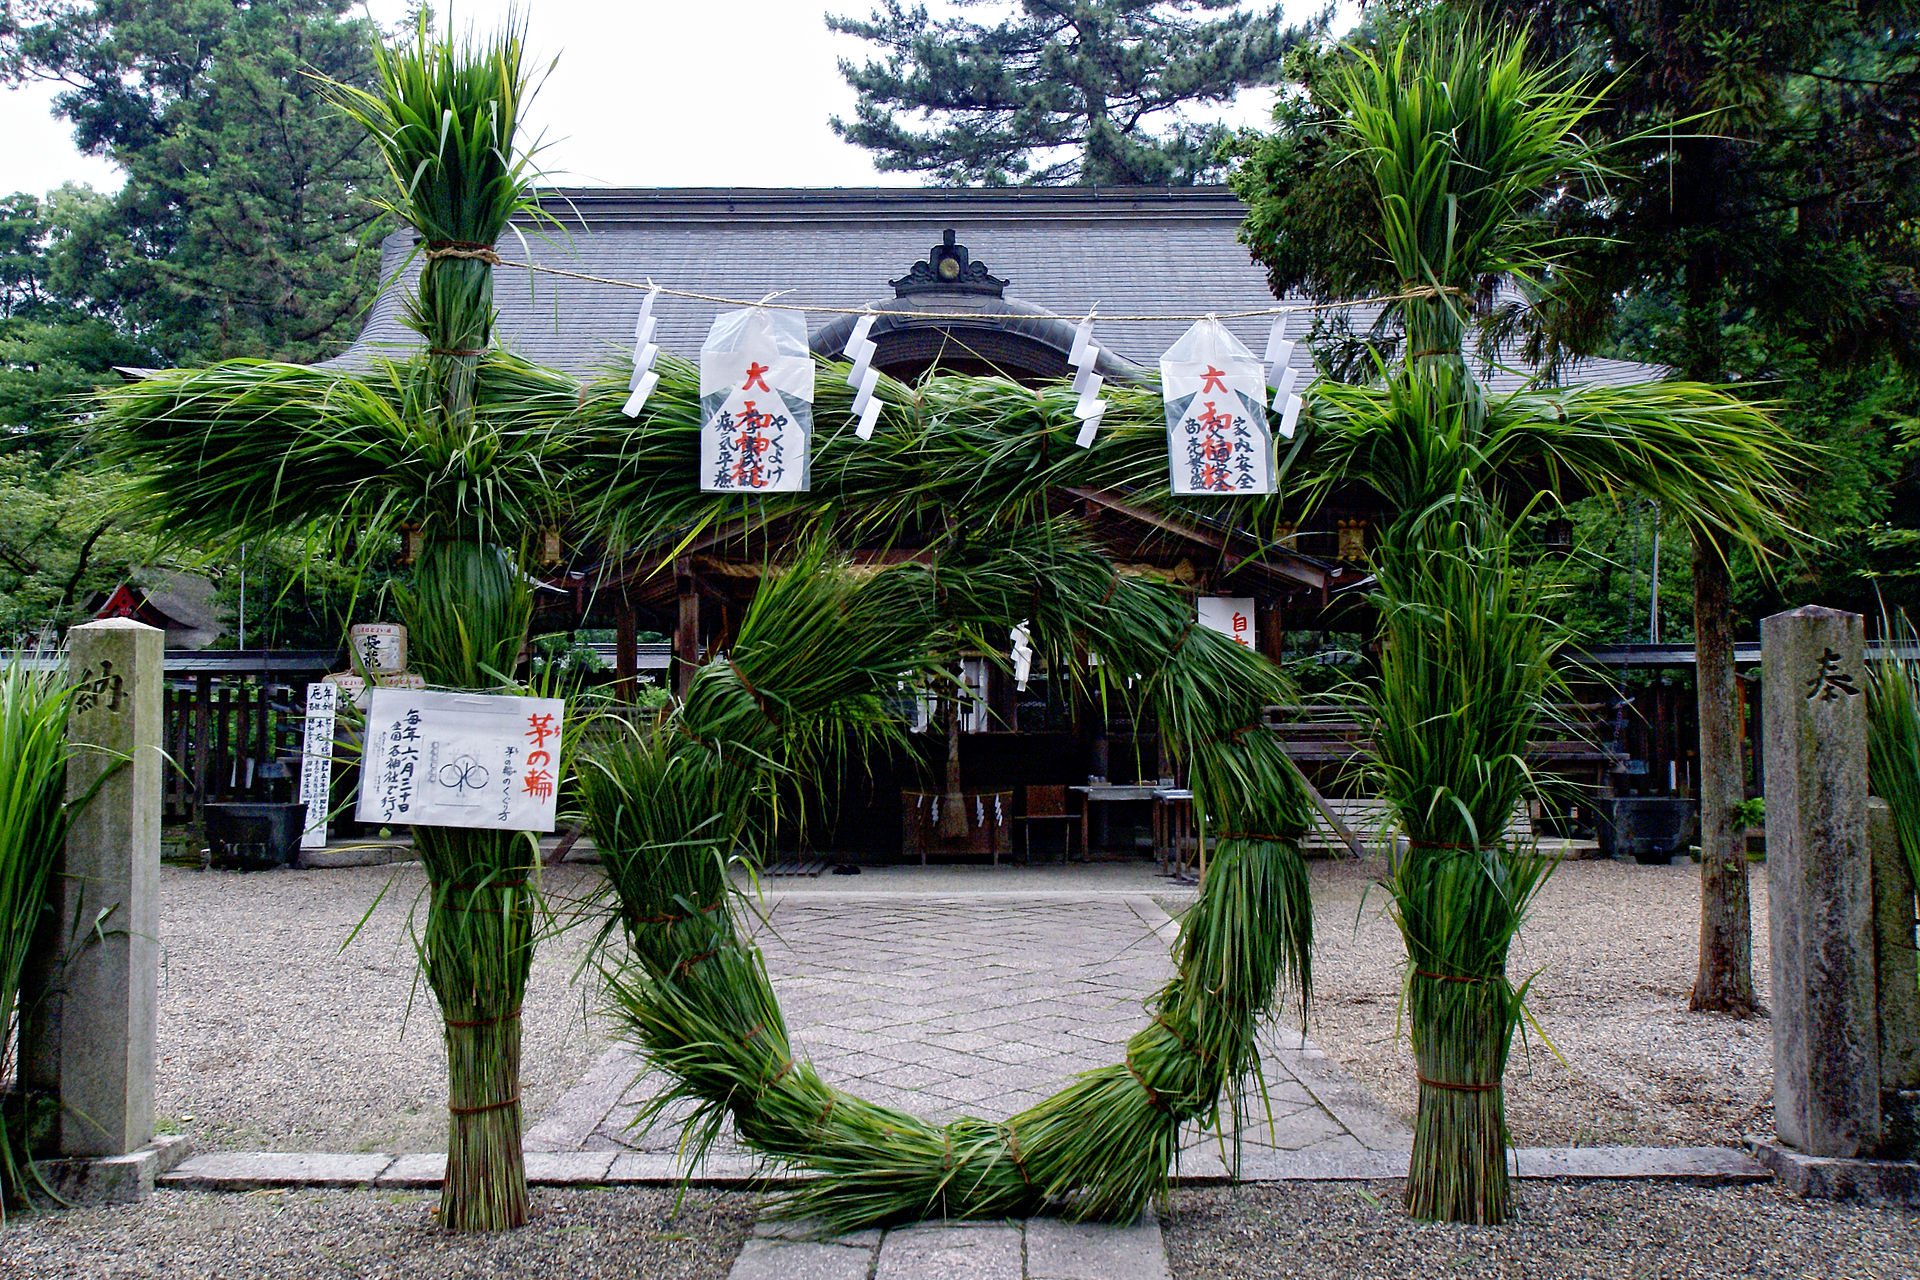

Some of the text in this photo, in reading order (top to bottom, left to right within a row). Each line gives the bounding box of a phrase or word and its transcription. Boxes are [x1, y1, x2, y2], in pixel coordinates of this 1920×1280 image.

[1232, 416, 1256, 489] 家内安全
[1805, 647, 1860, 702] 奉
[381, 721, 402, 822] 全国各神社で行う
[398, 708, 422, 812] 毎年六月三十日
[522, 713, 555, 805] 茅の輪
